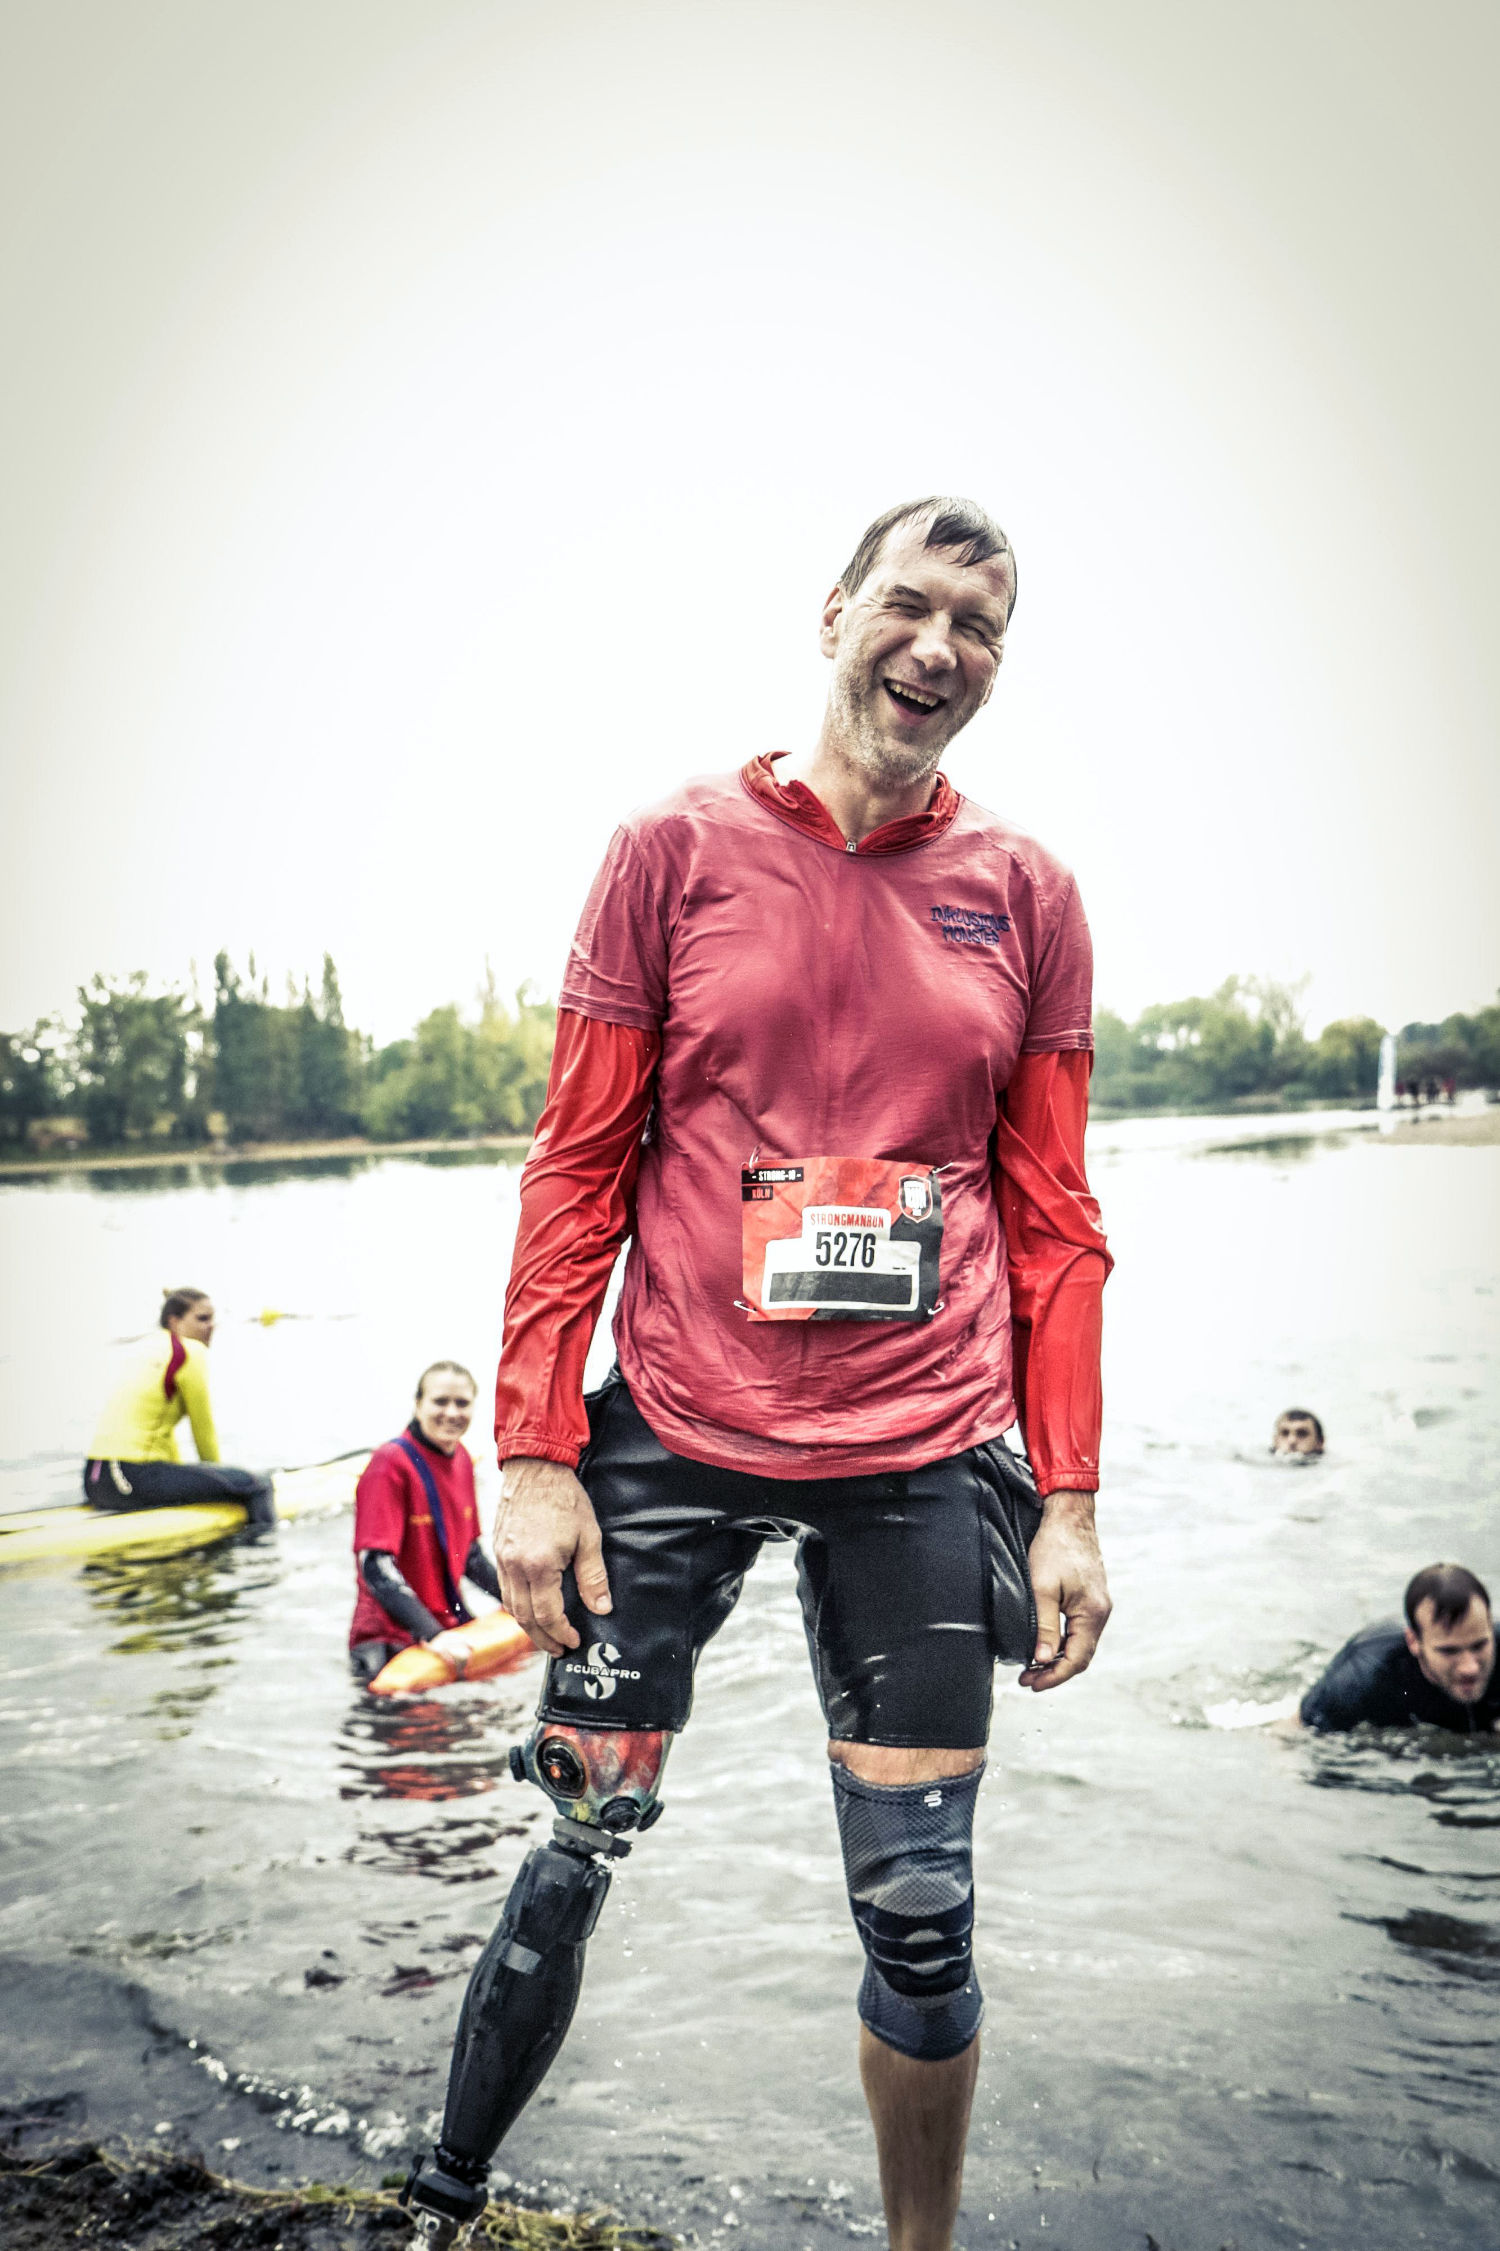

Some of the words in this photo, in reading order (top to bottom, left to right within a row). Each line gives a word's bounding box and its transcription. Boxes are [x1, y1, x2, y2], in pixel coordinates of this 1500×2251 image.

[752, 1187, 771, 1199] KÖLN
[810, 1212, 884, 1229] STRONGMANRUN
[815, 1231, 876, 1269] 5276
[565, 1663, 641, 1680] SCUBAPRO
